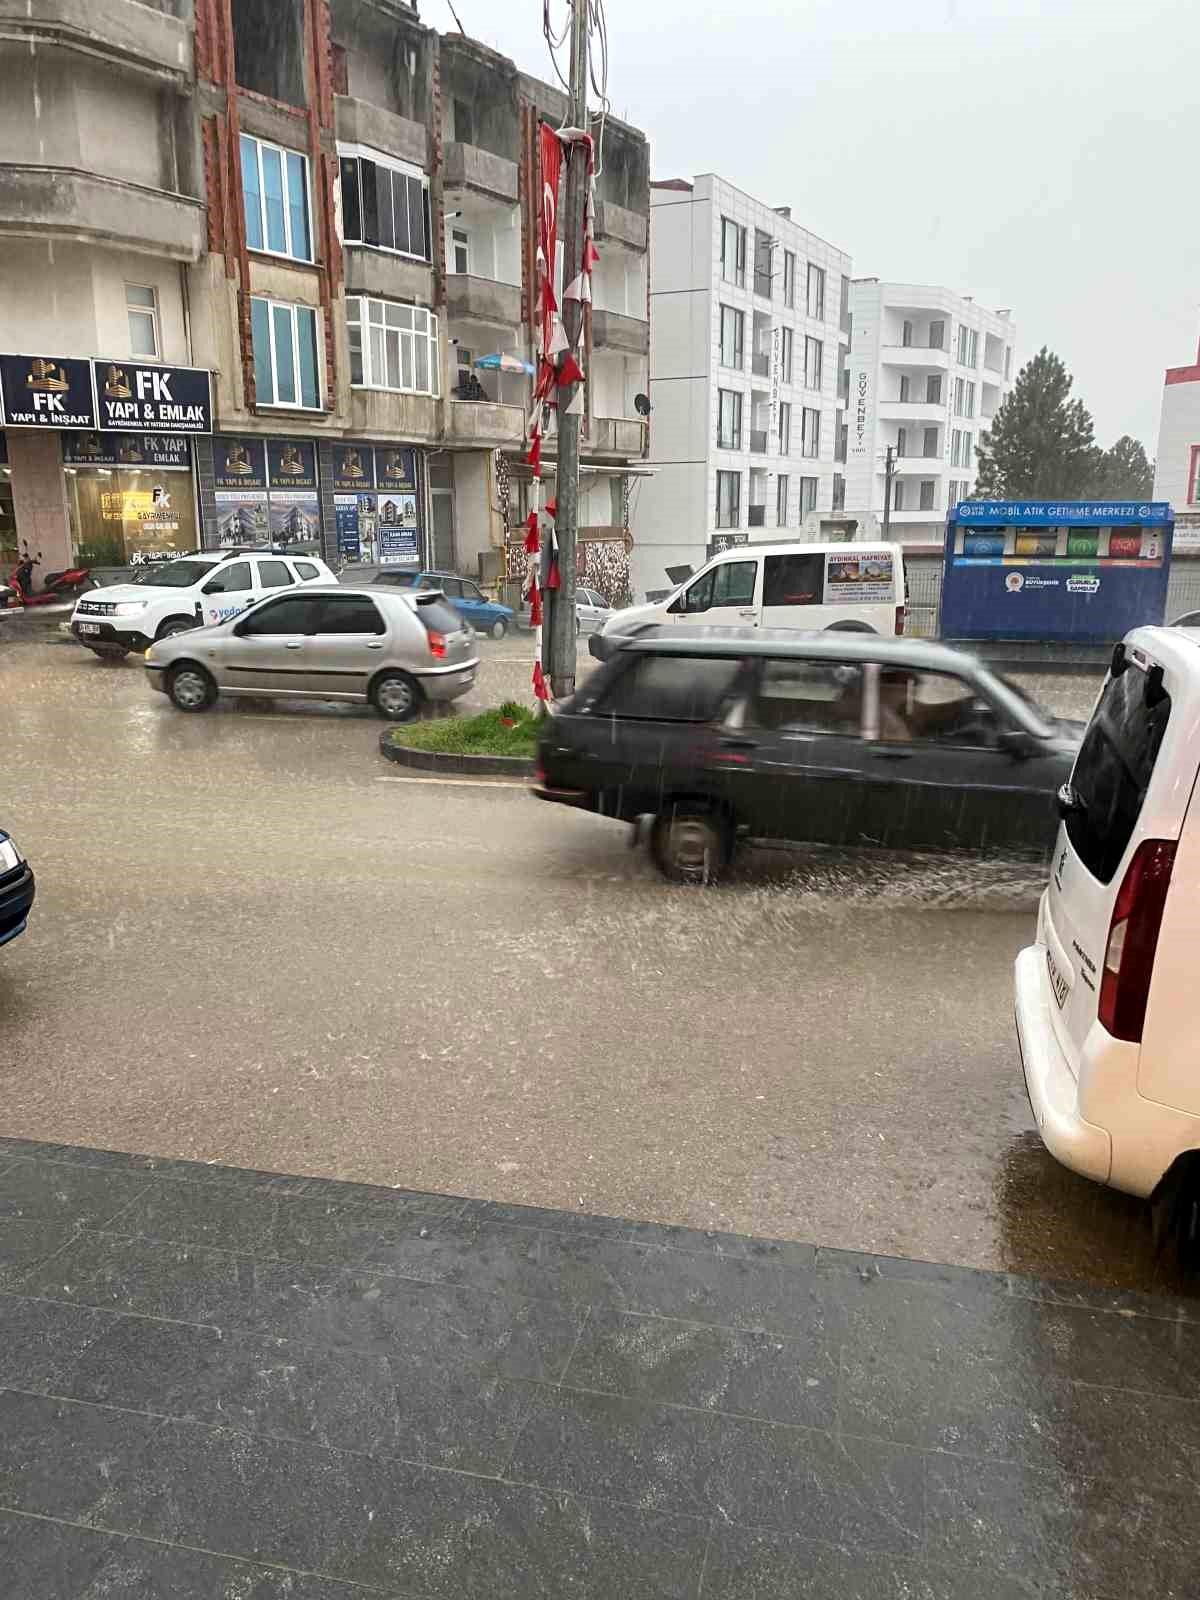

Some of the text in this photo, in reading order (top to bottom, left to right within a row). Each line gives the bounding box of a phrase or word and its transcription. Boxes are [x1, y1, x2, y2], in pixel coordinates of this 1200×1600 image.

[136, 371, 173, 401] FK
[33, 393, 65, 411] FK
[11, 412, 90, 425] YAPI & İNŞAAT
[105, 401, 205, 421] YAPI & EMLAK
[143, 437, 187, 452] FK YAPI
[154, 453, 180, 463] EMLAK
[988, 505, 1021, 516] MOBİL
[1024, 507, 1044, 516] ATIK
